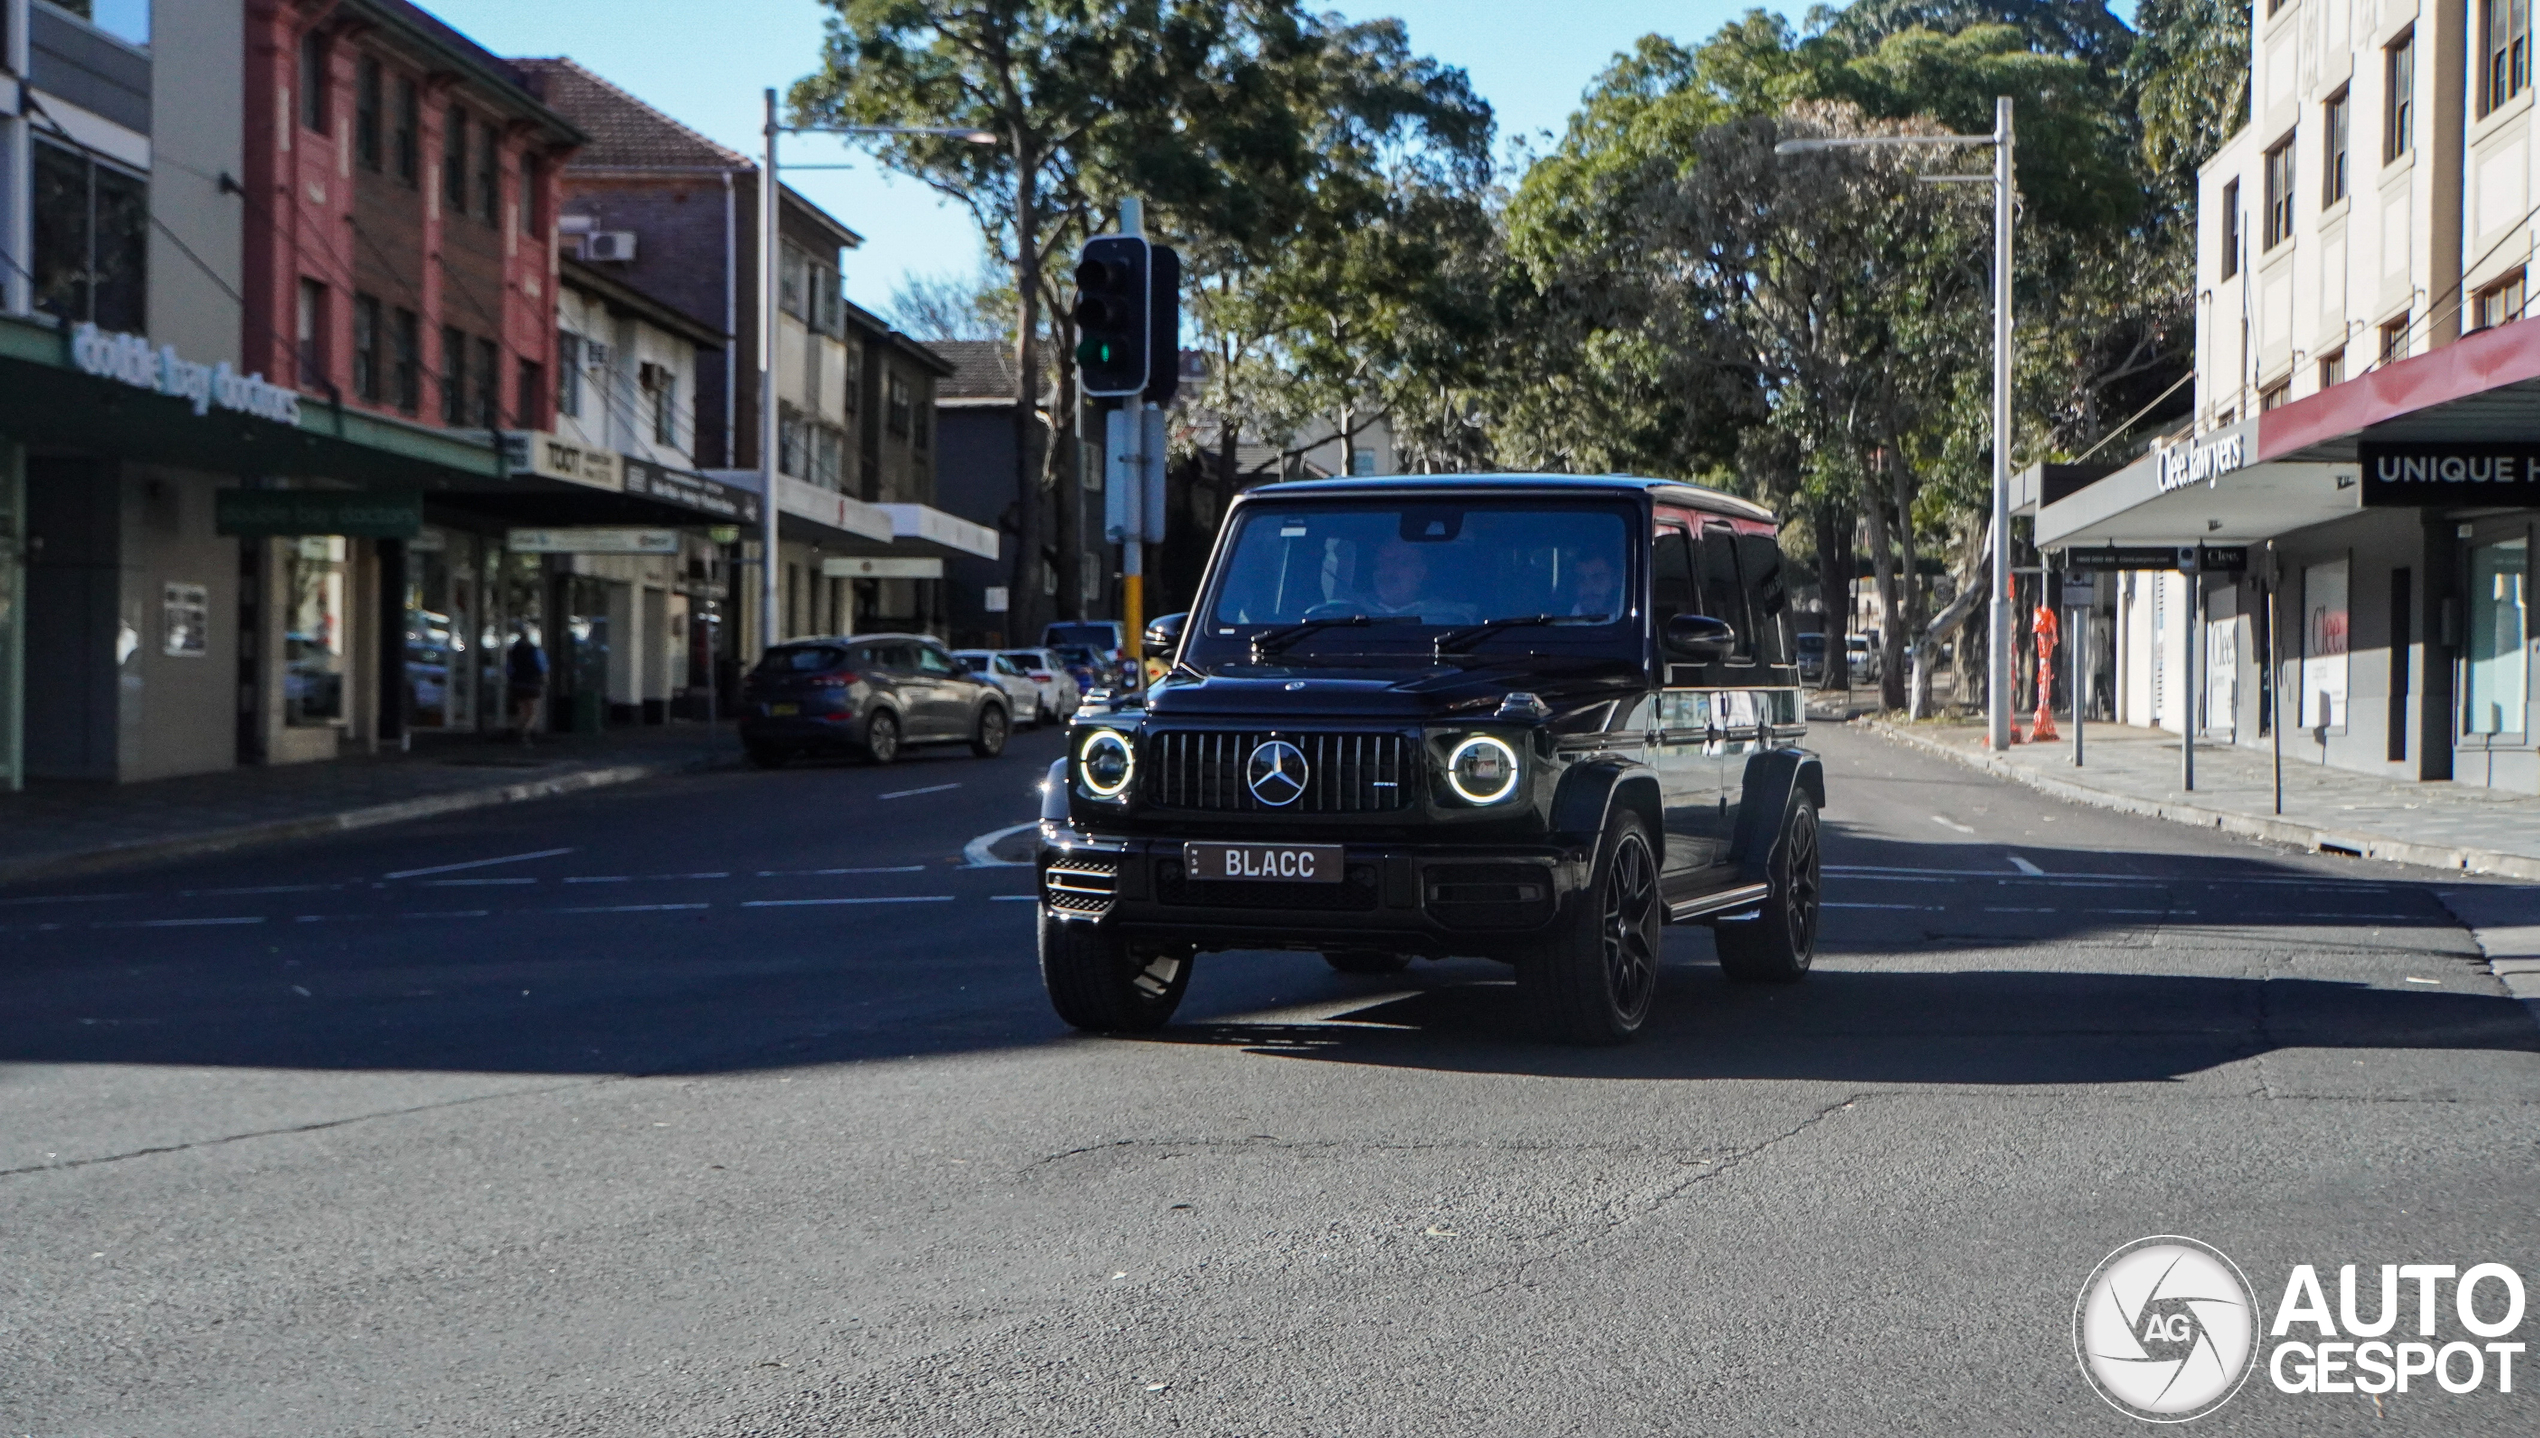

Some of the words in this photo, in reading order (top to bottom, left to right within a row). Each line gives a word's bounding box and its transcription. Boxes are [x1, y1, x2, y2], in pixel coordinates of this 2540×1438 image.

[161, 344, 212, 416] bay
[214, 361, 299, 426] doctors
[2377, 456, 2514, 483] UNIQUE
[1225, 850, 1315, 877] BLACC
